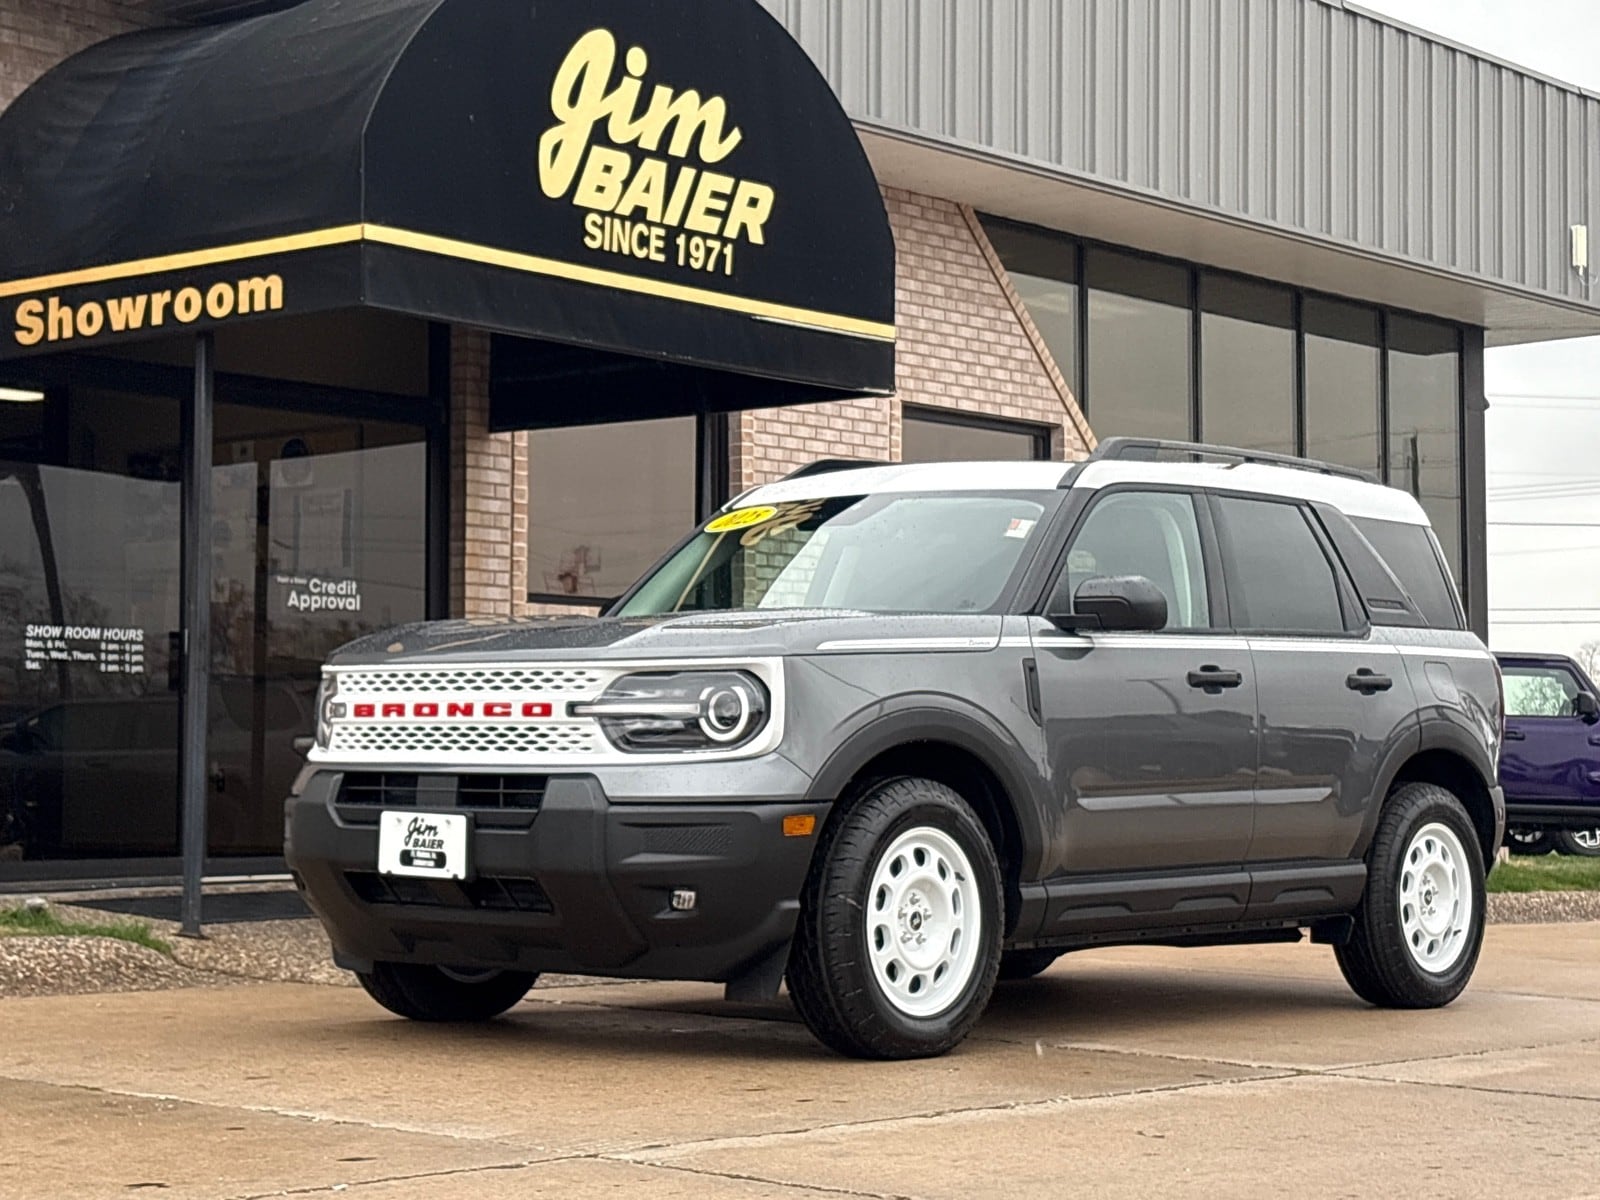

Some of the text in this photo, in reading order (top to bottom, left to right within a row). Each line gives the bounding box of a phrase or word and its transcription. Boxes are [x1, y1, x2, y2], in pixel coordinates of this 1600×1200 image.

[538, 28, 742, 199] Jim
[572, 145, 774, 245] BAIER
[583, 213, 734, 276] SINCE 1971
[14, 274, 283, 346] Showroom
[309, 578, 357, 595] Credit
[287, 590, 360, 612] Approval
[26, 624, 144, 641] SHOW ROOM HOURS
[353, 702, 552, 718] BRONCO
[404, 816, 439, 847] Jim
[412, 838, 445, 849] BAIER
